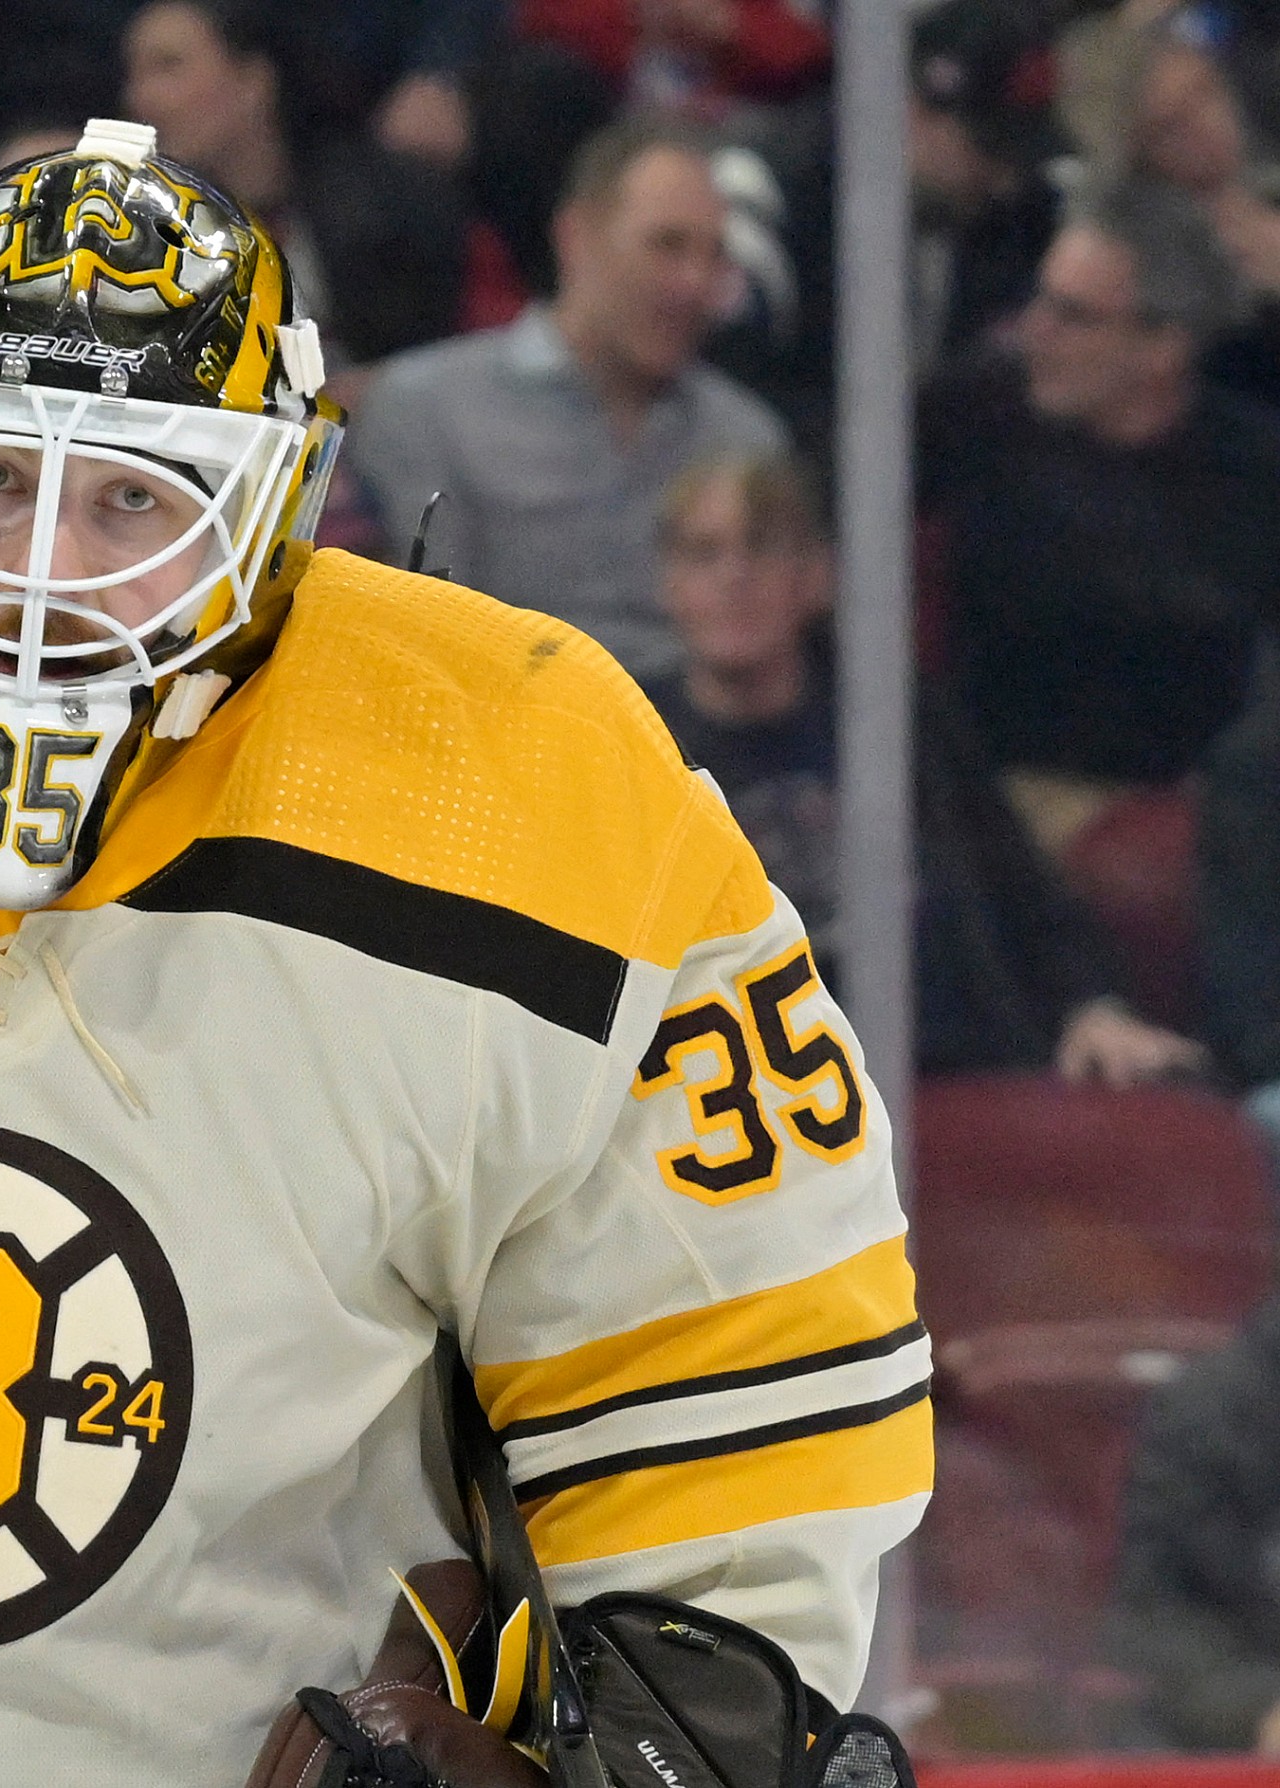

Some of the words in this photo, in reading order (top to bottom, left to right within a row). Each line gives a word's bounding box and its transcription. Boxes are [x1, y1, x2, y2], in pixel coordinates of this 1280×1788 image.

[631, 937, 867, 1207] 35
[77, 1372, 166, 1444] 24
[637, 1739, 687, 1788] ULLM
